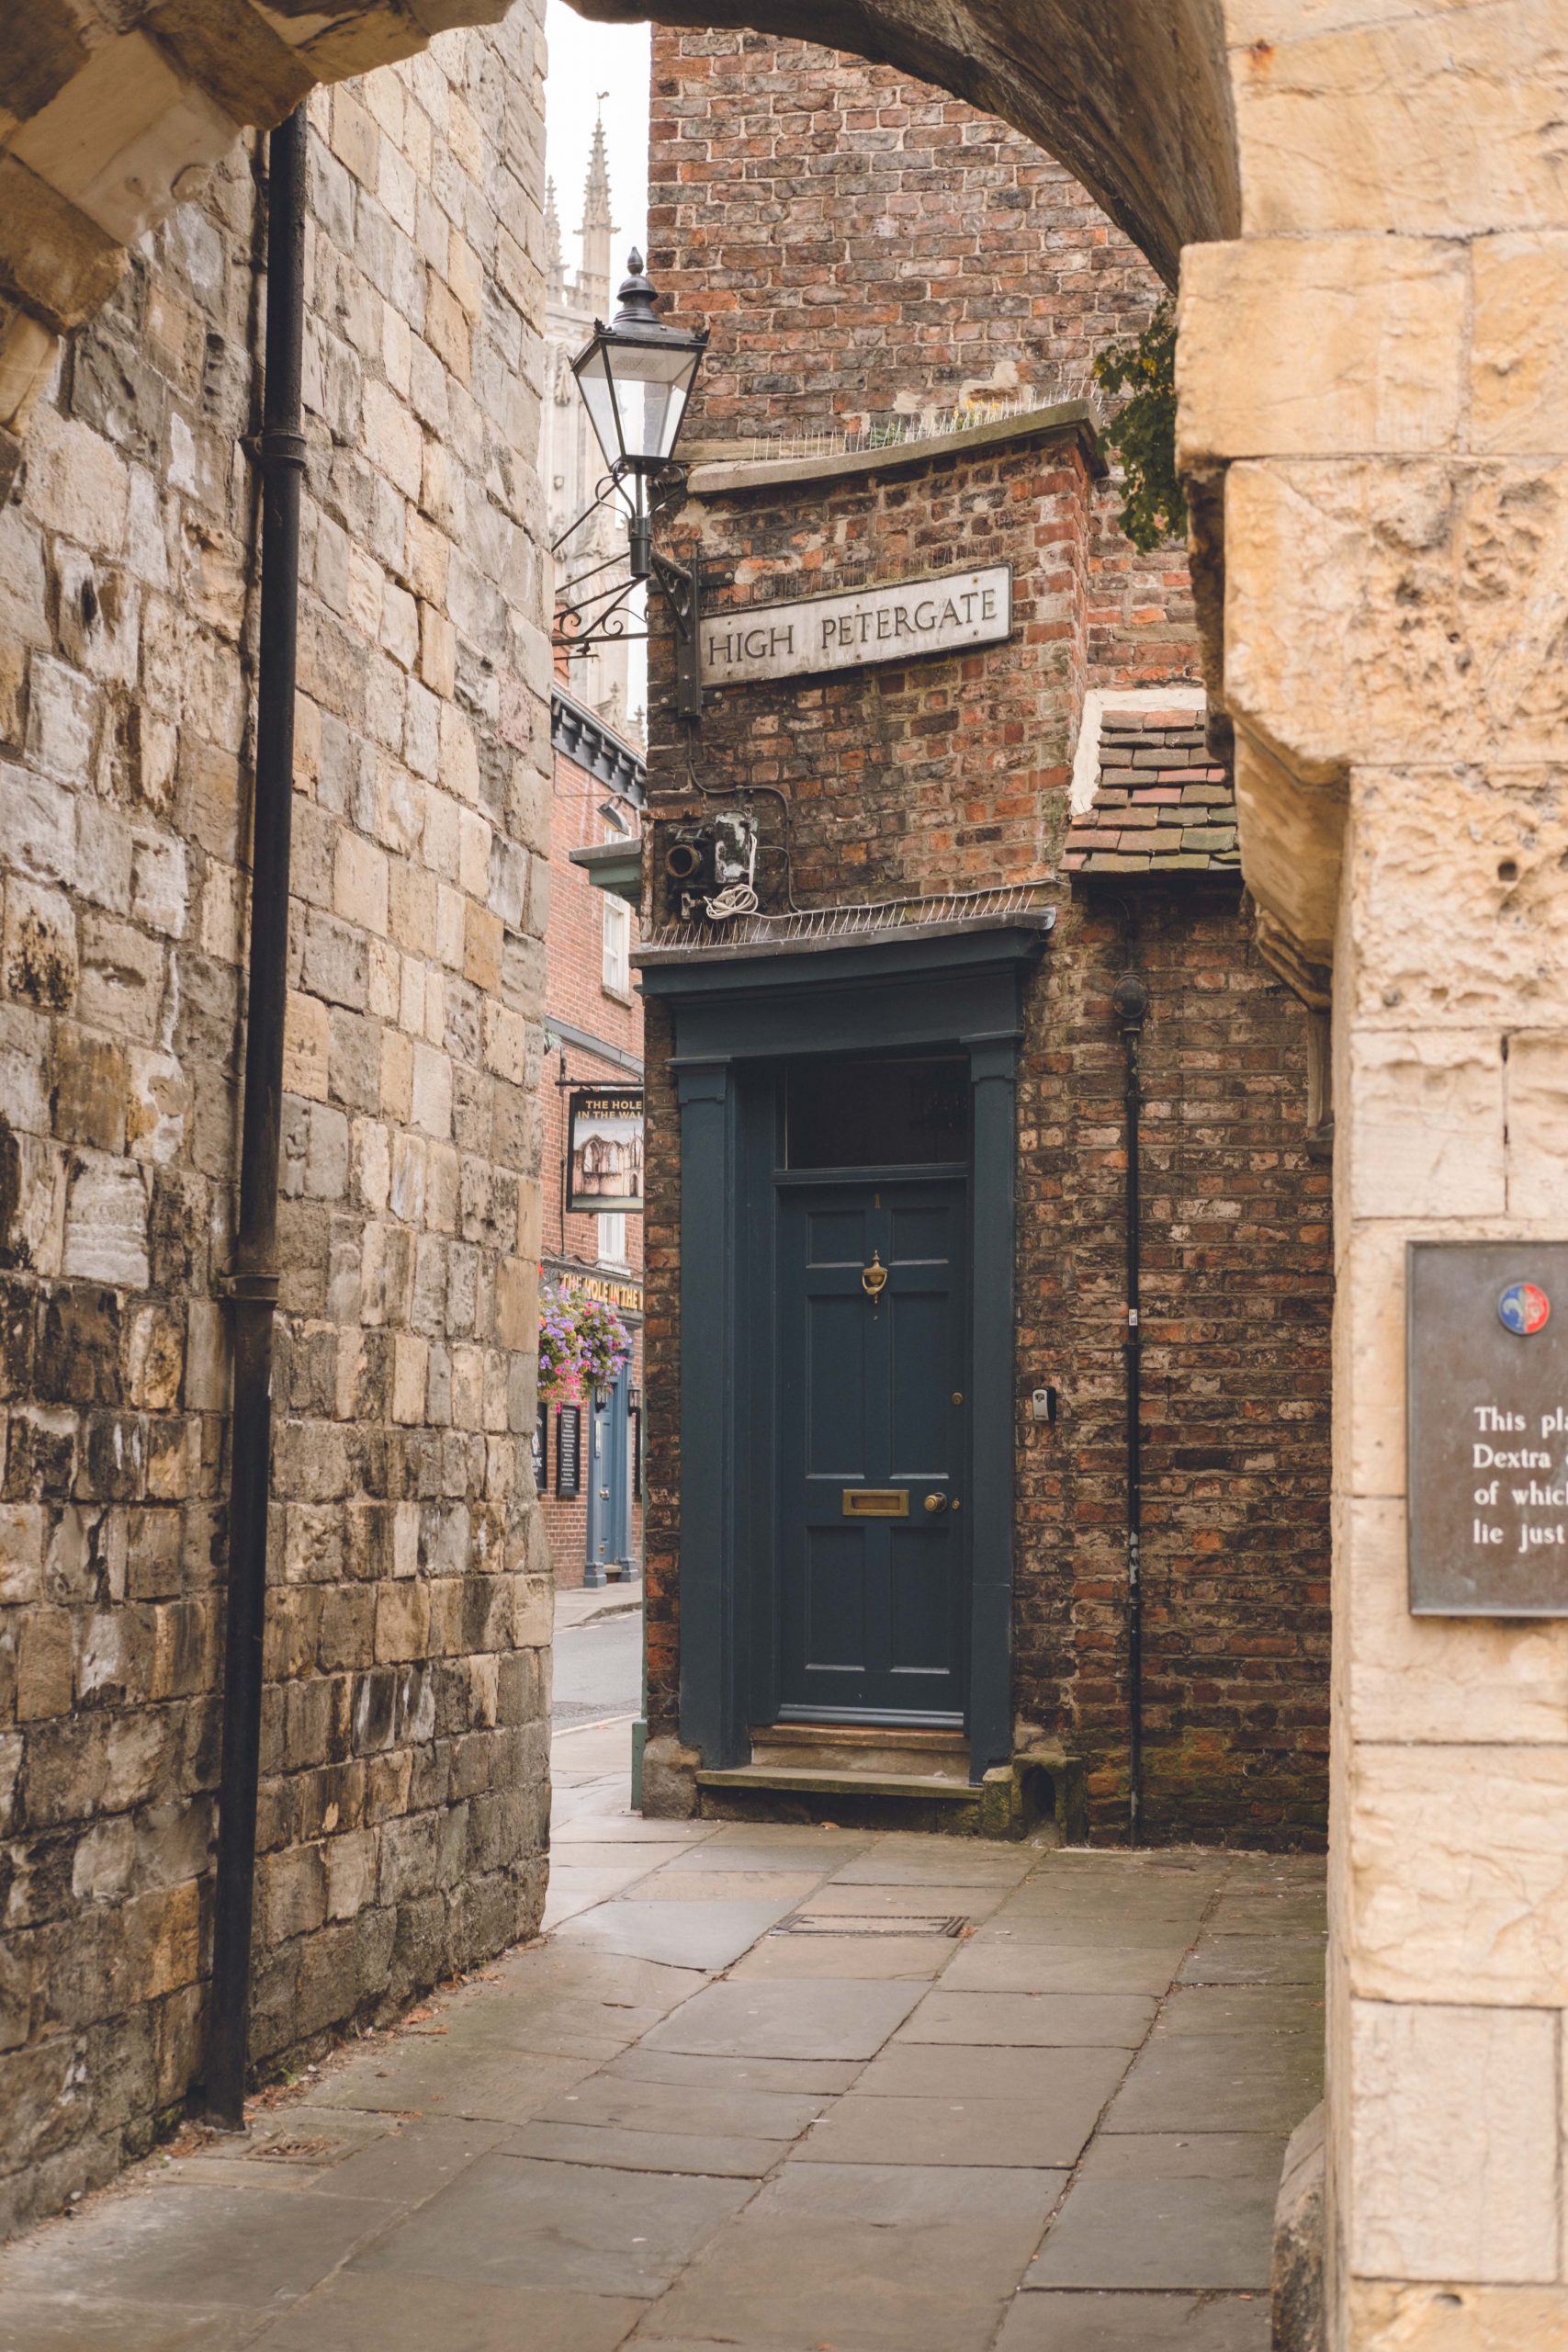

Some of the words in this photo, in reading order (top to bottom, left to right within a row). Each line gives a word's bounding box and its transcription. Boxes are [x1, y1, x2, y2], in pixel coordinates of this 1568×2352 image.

[708, 625, 794, 665] HIGH
[821, 589, 998, 649] PETERGATE
[578, 1110, 590, 1119] IN
[592, 1111, 615, 1120] THE
[585, 1101, 608, 1110] THE
[612, 1101, 642, 1110] HOLE
[619, 1285, 638, 1309] THE
[1473, 1406, 1526, 1431] This
[1472, 1443, 1551, 1468] Dextra
[1473, 1480, 1499, 1505] of
[1511, 1479, 1568, 1505] whic
[1473, 1518, 1504, 1544] lie
[1518, 1523, 1565, 1553] just
